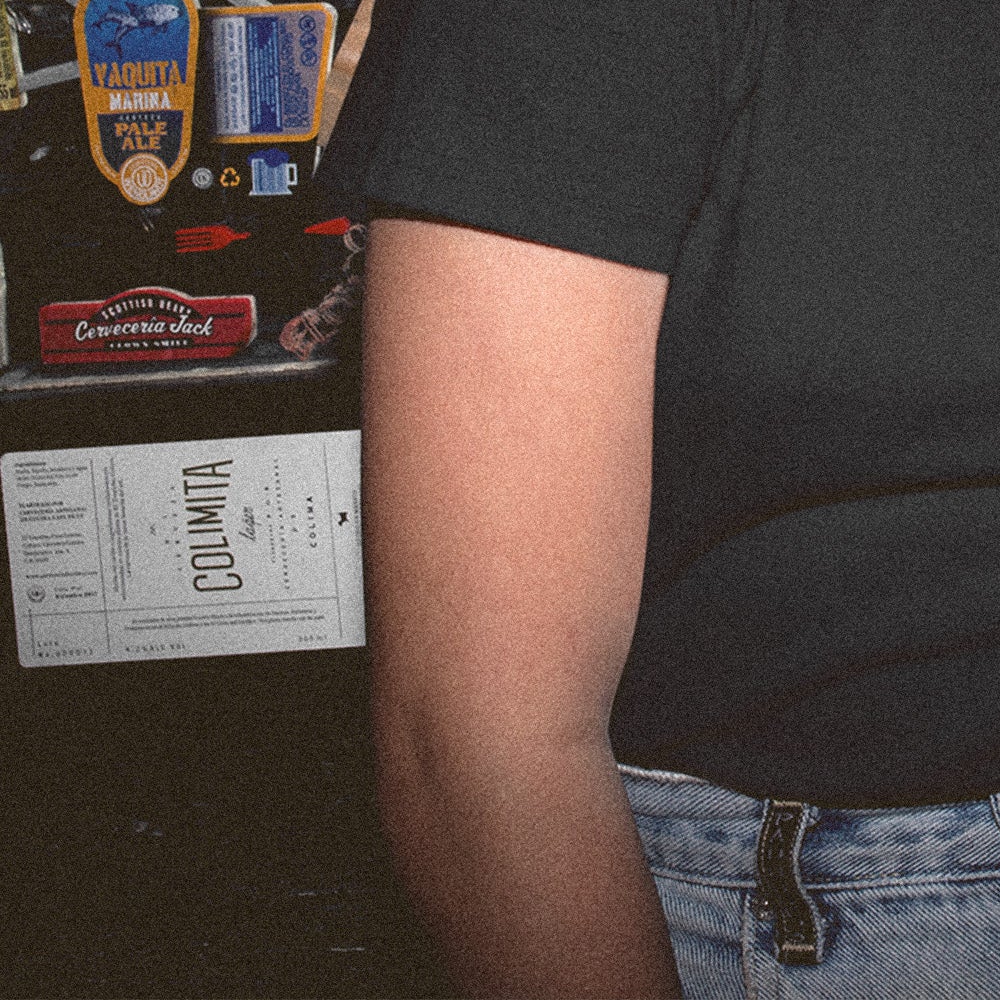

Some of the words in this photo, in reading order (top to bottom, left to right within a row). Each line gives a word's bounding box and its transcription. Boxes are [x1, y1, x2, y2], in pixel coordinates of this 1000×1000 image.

[109, 91, 172, 111] MARINA
[114, 121, 168, 136] PALE
[122, 136, 161, 150] ALE
[75, 316, 167, 341] Cervecería
[169, 314, 213, 336] Jack
[182, 459, 243, 593] COLIMITA
[306, 496, 318, 549] COLIMA
